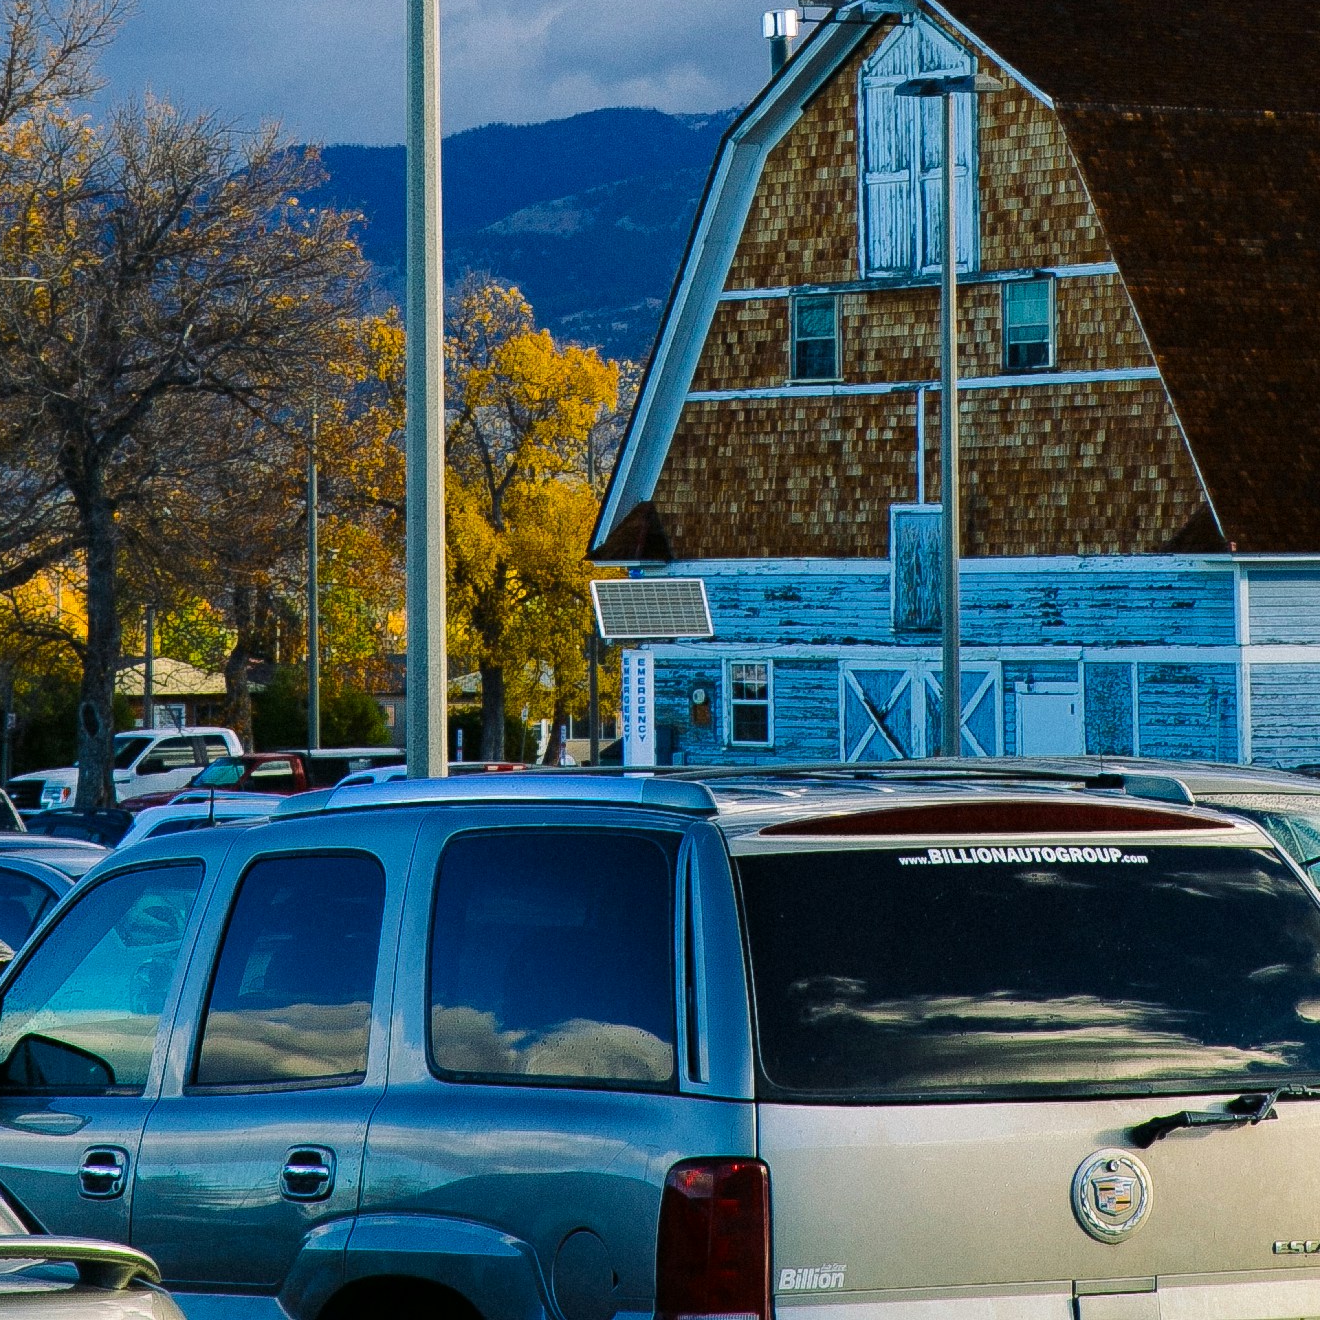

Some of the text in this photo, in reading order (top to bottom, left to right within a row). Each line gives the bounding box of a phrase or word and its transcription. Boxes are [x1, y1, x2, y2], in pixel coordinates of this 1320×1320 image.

[637, 658, 647, 743] EMERGENCY
[898, 847, 1148, 865] www.BILLIONAUTOGROUP.com
[779, 1267, 845, 1290] Billion
